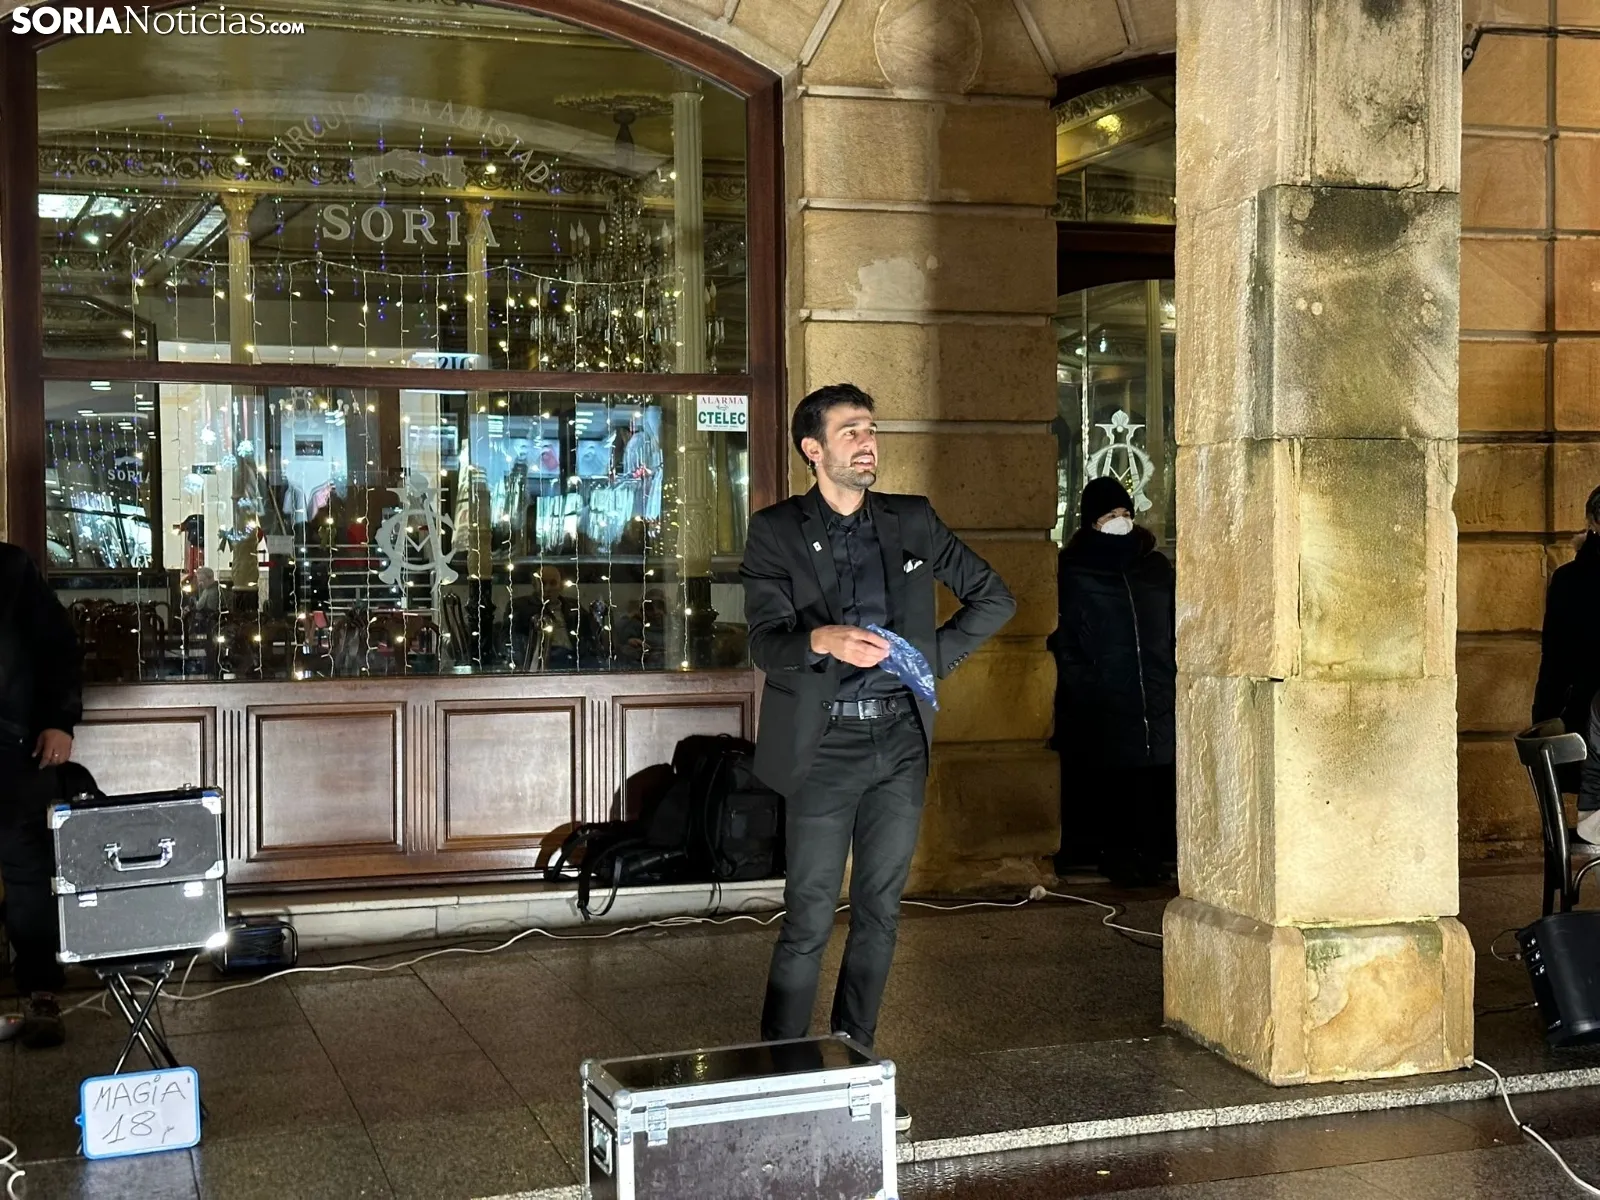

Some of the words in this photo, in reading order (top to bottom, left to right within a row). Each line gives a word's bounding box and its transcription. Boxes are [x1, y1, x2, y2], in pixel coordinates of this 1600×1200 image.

[437, 99, 549, 184] AMISTAD
[322, 204, 500, 248] SORIA
[698, 411, 746, 425] CTELEC
